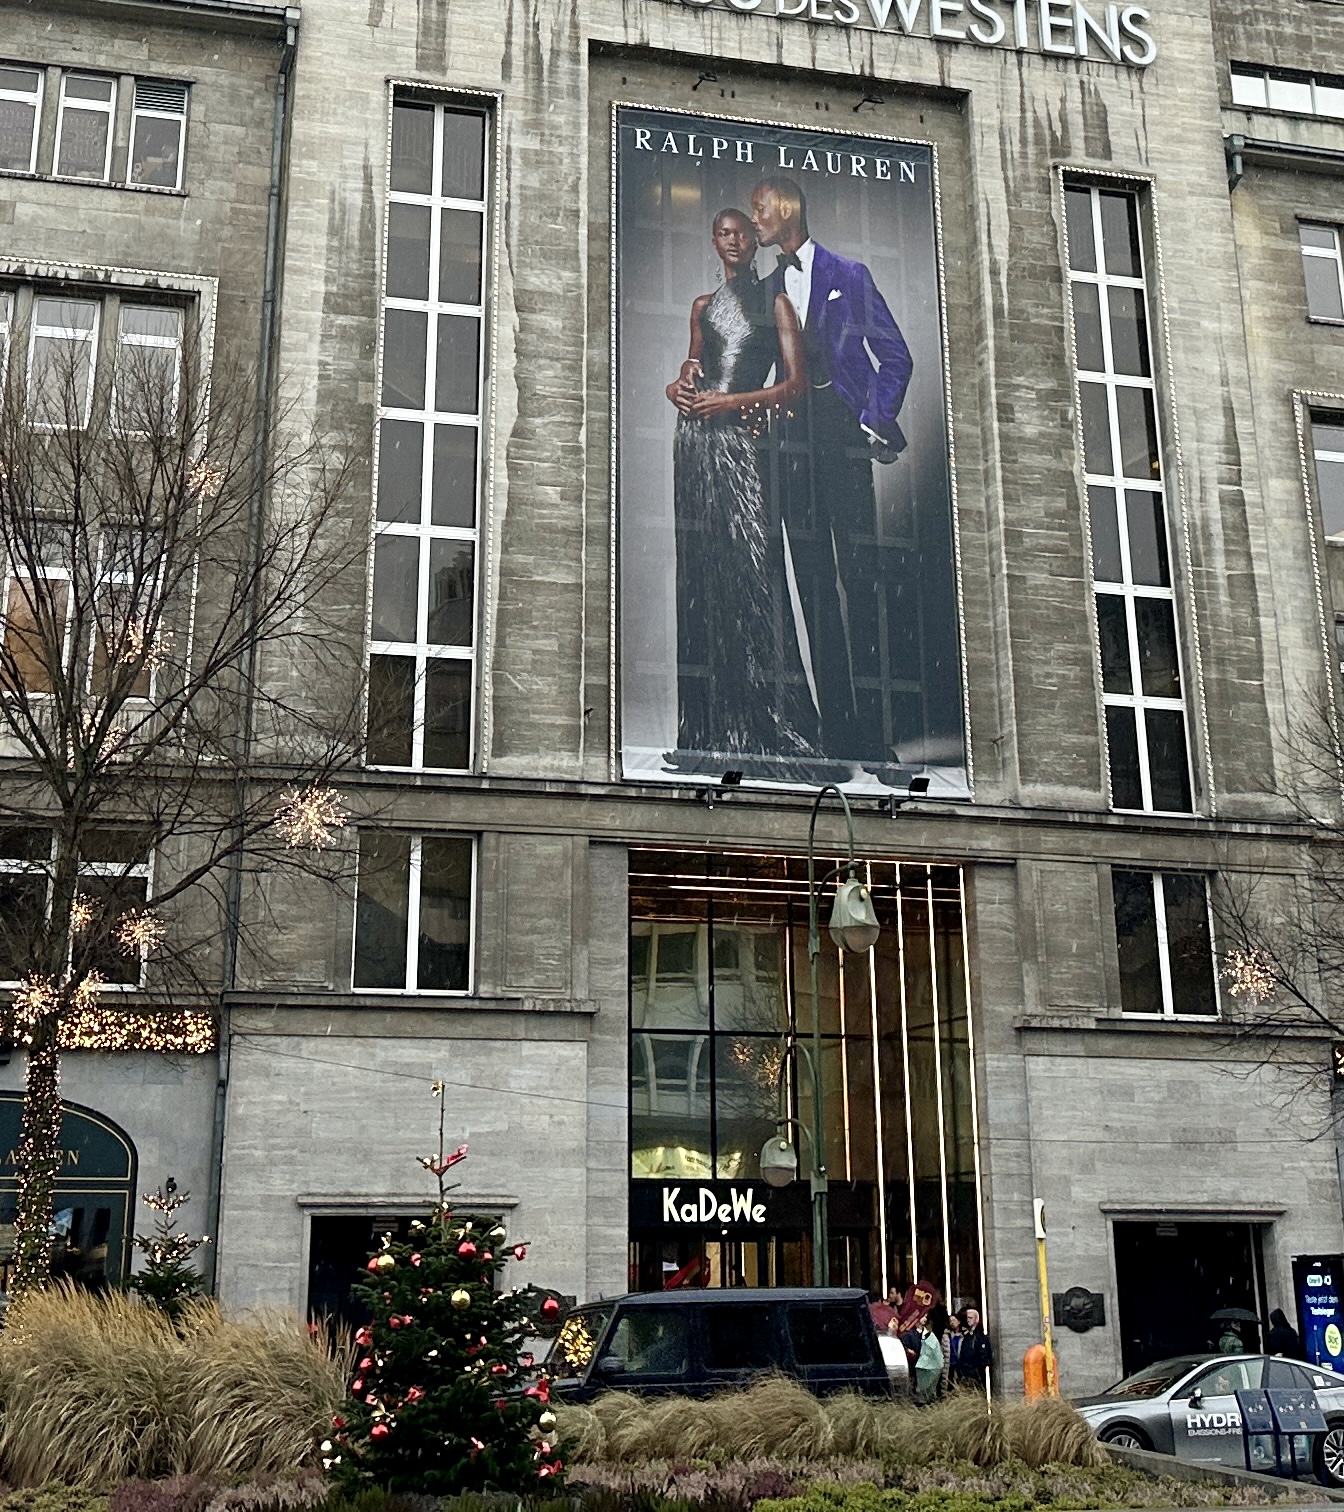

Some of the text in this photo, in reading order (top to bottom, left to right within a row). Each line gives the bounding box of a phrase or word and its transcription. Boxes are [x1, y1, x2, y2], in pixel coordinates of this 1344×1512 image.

[634, 128, 916, 184] RALPH LAUREN
[662, 1187, 767, 1223] KaDeWe
[1186, 1413, 1243, 1429] HYDR
